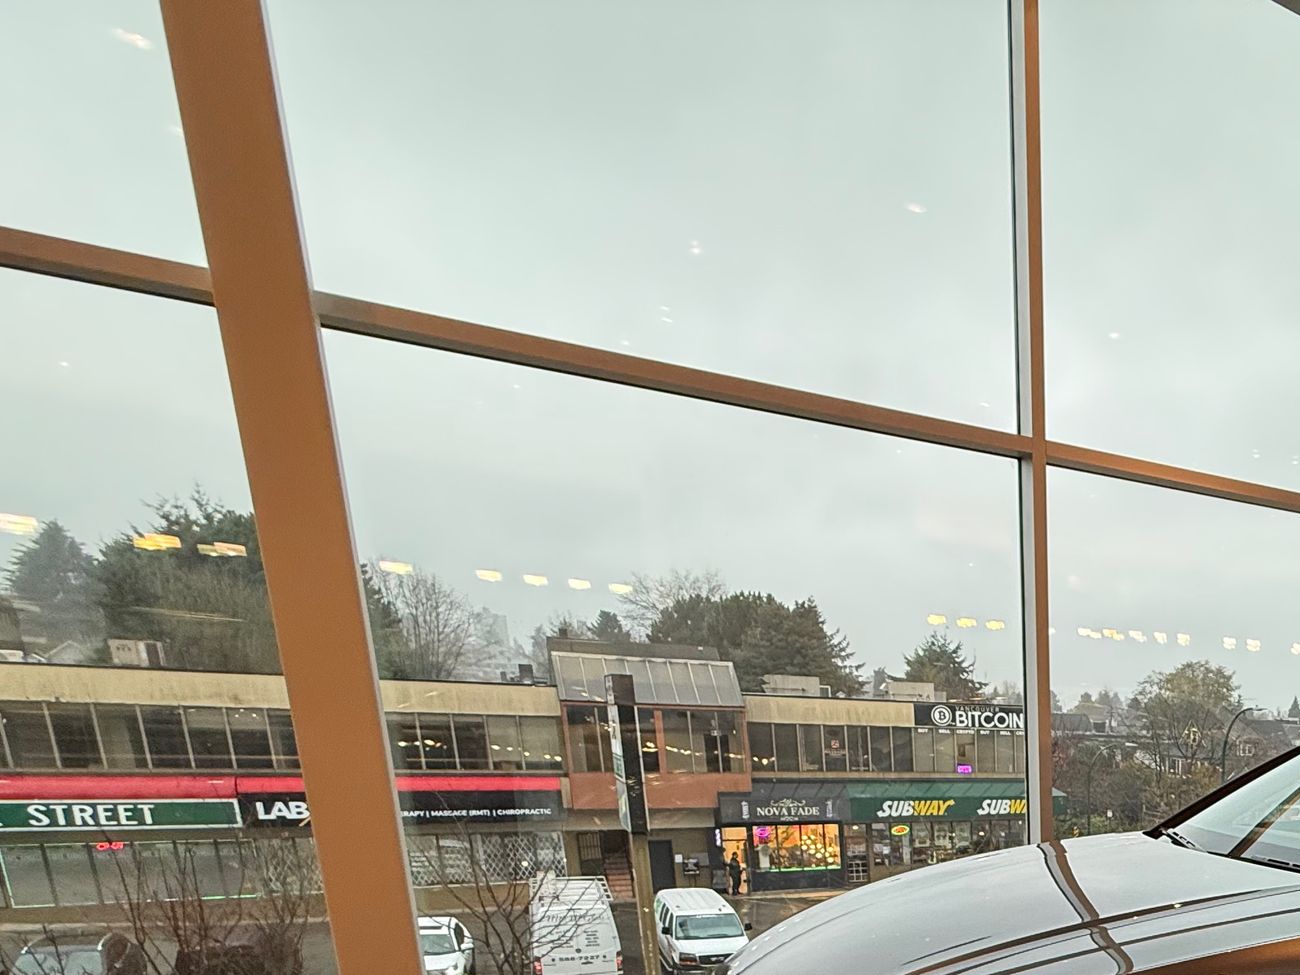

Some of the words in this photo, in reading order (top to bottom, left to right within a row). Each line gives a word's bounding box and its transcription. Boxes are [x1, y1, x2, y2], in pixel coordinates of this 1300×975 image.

[955, 711, 1024, 728] BITCOIN
[26, 804, 155, 826] STREET
[255, 801, 311, 820] LAB
[430, 809, 468, 817] MASSAGE
[497, 808, 552, 816] CHIROPRACTIC
[756, 806, 788, 816] NOVA
[791, 806, 820, 816] FADE
[876, 799, 955, 817] SUBWAY
